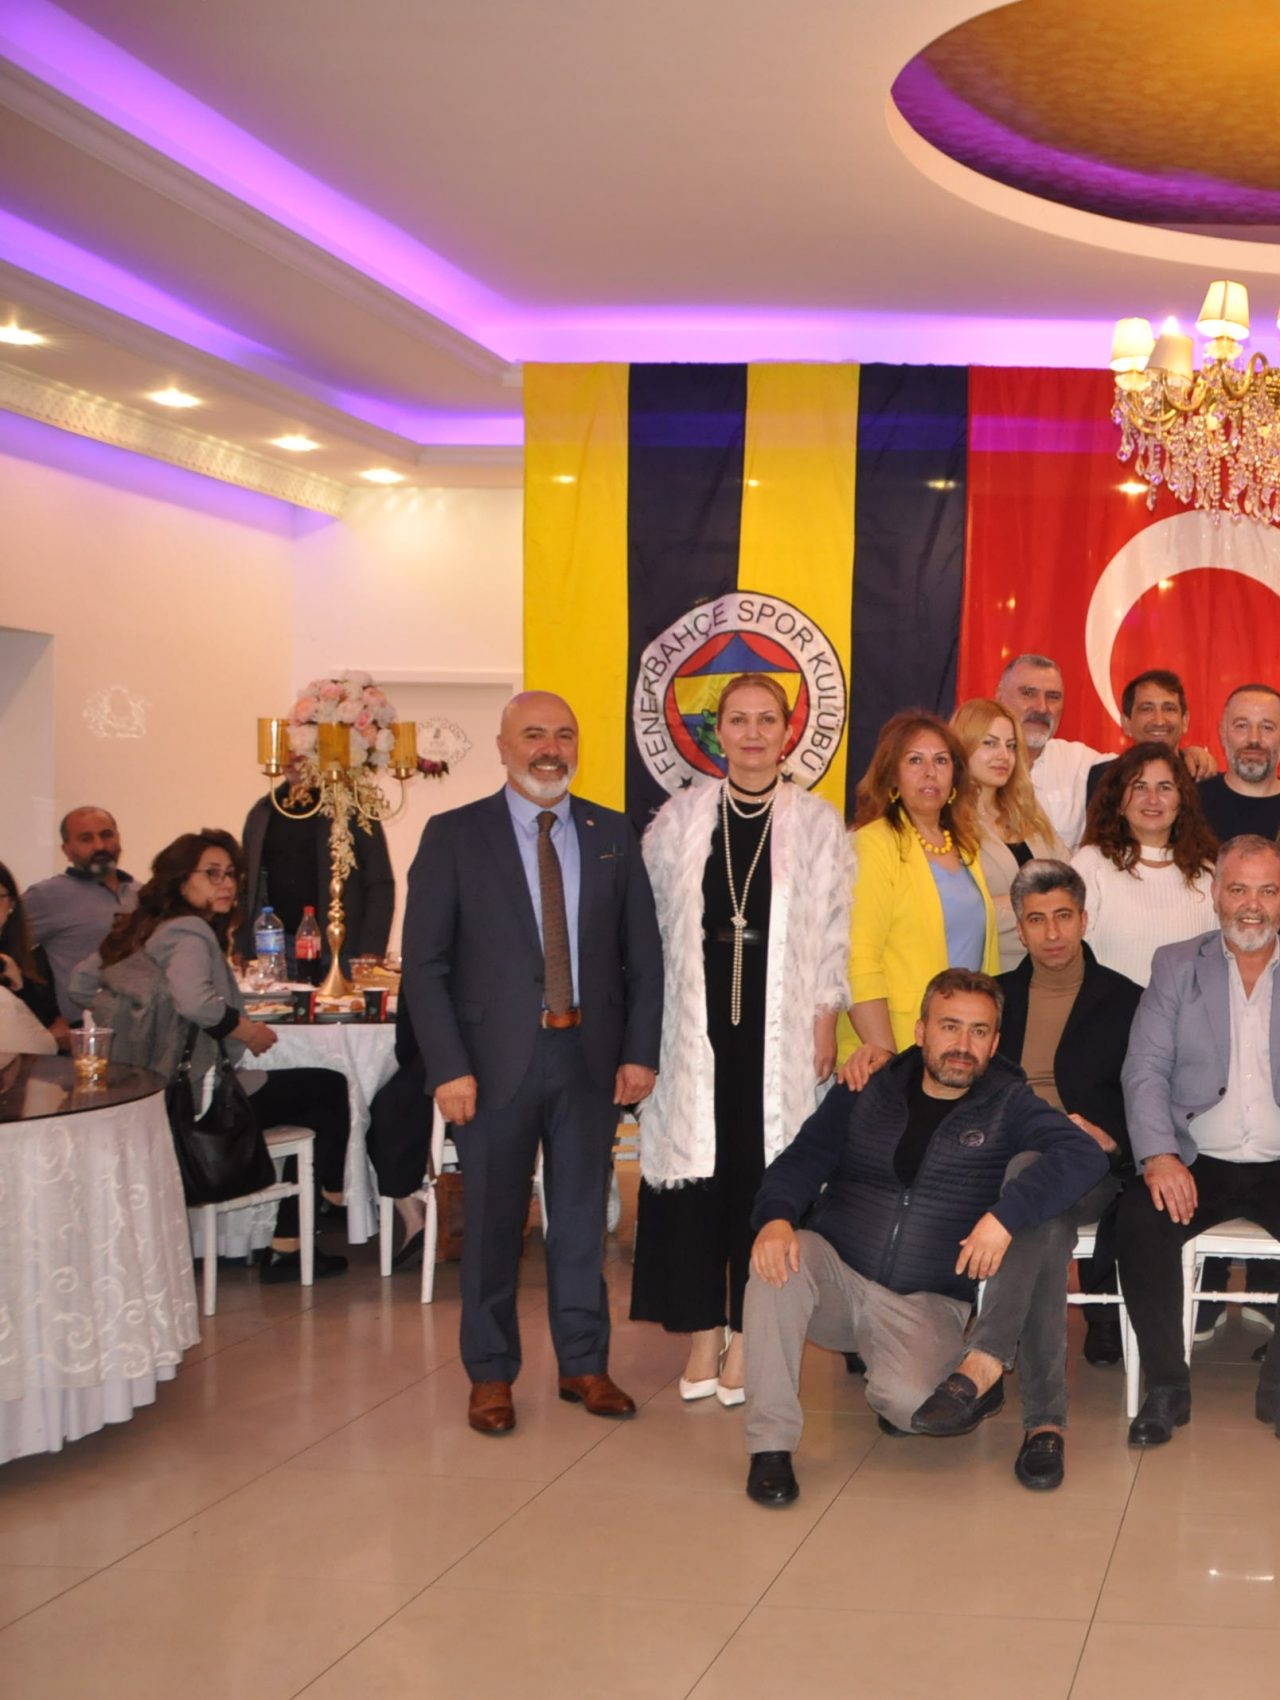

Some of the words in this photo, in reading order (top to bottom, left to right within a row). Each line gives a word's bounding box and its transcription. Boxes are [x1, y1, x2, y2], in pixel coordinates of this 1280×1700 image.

[640, 602, 728, 776] FENERBAHÇE
[737, 600, 814, 652] SPOR
[800, 651, 841, 772] KULÜBÜ
